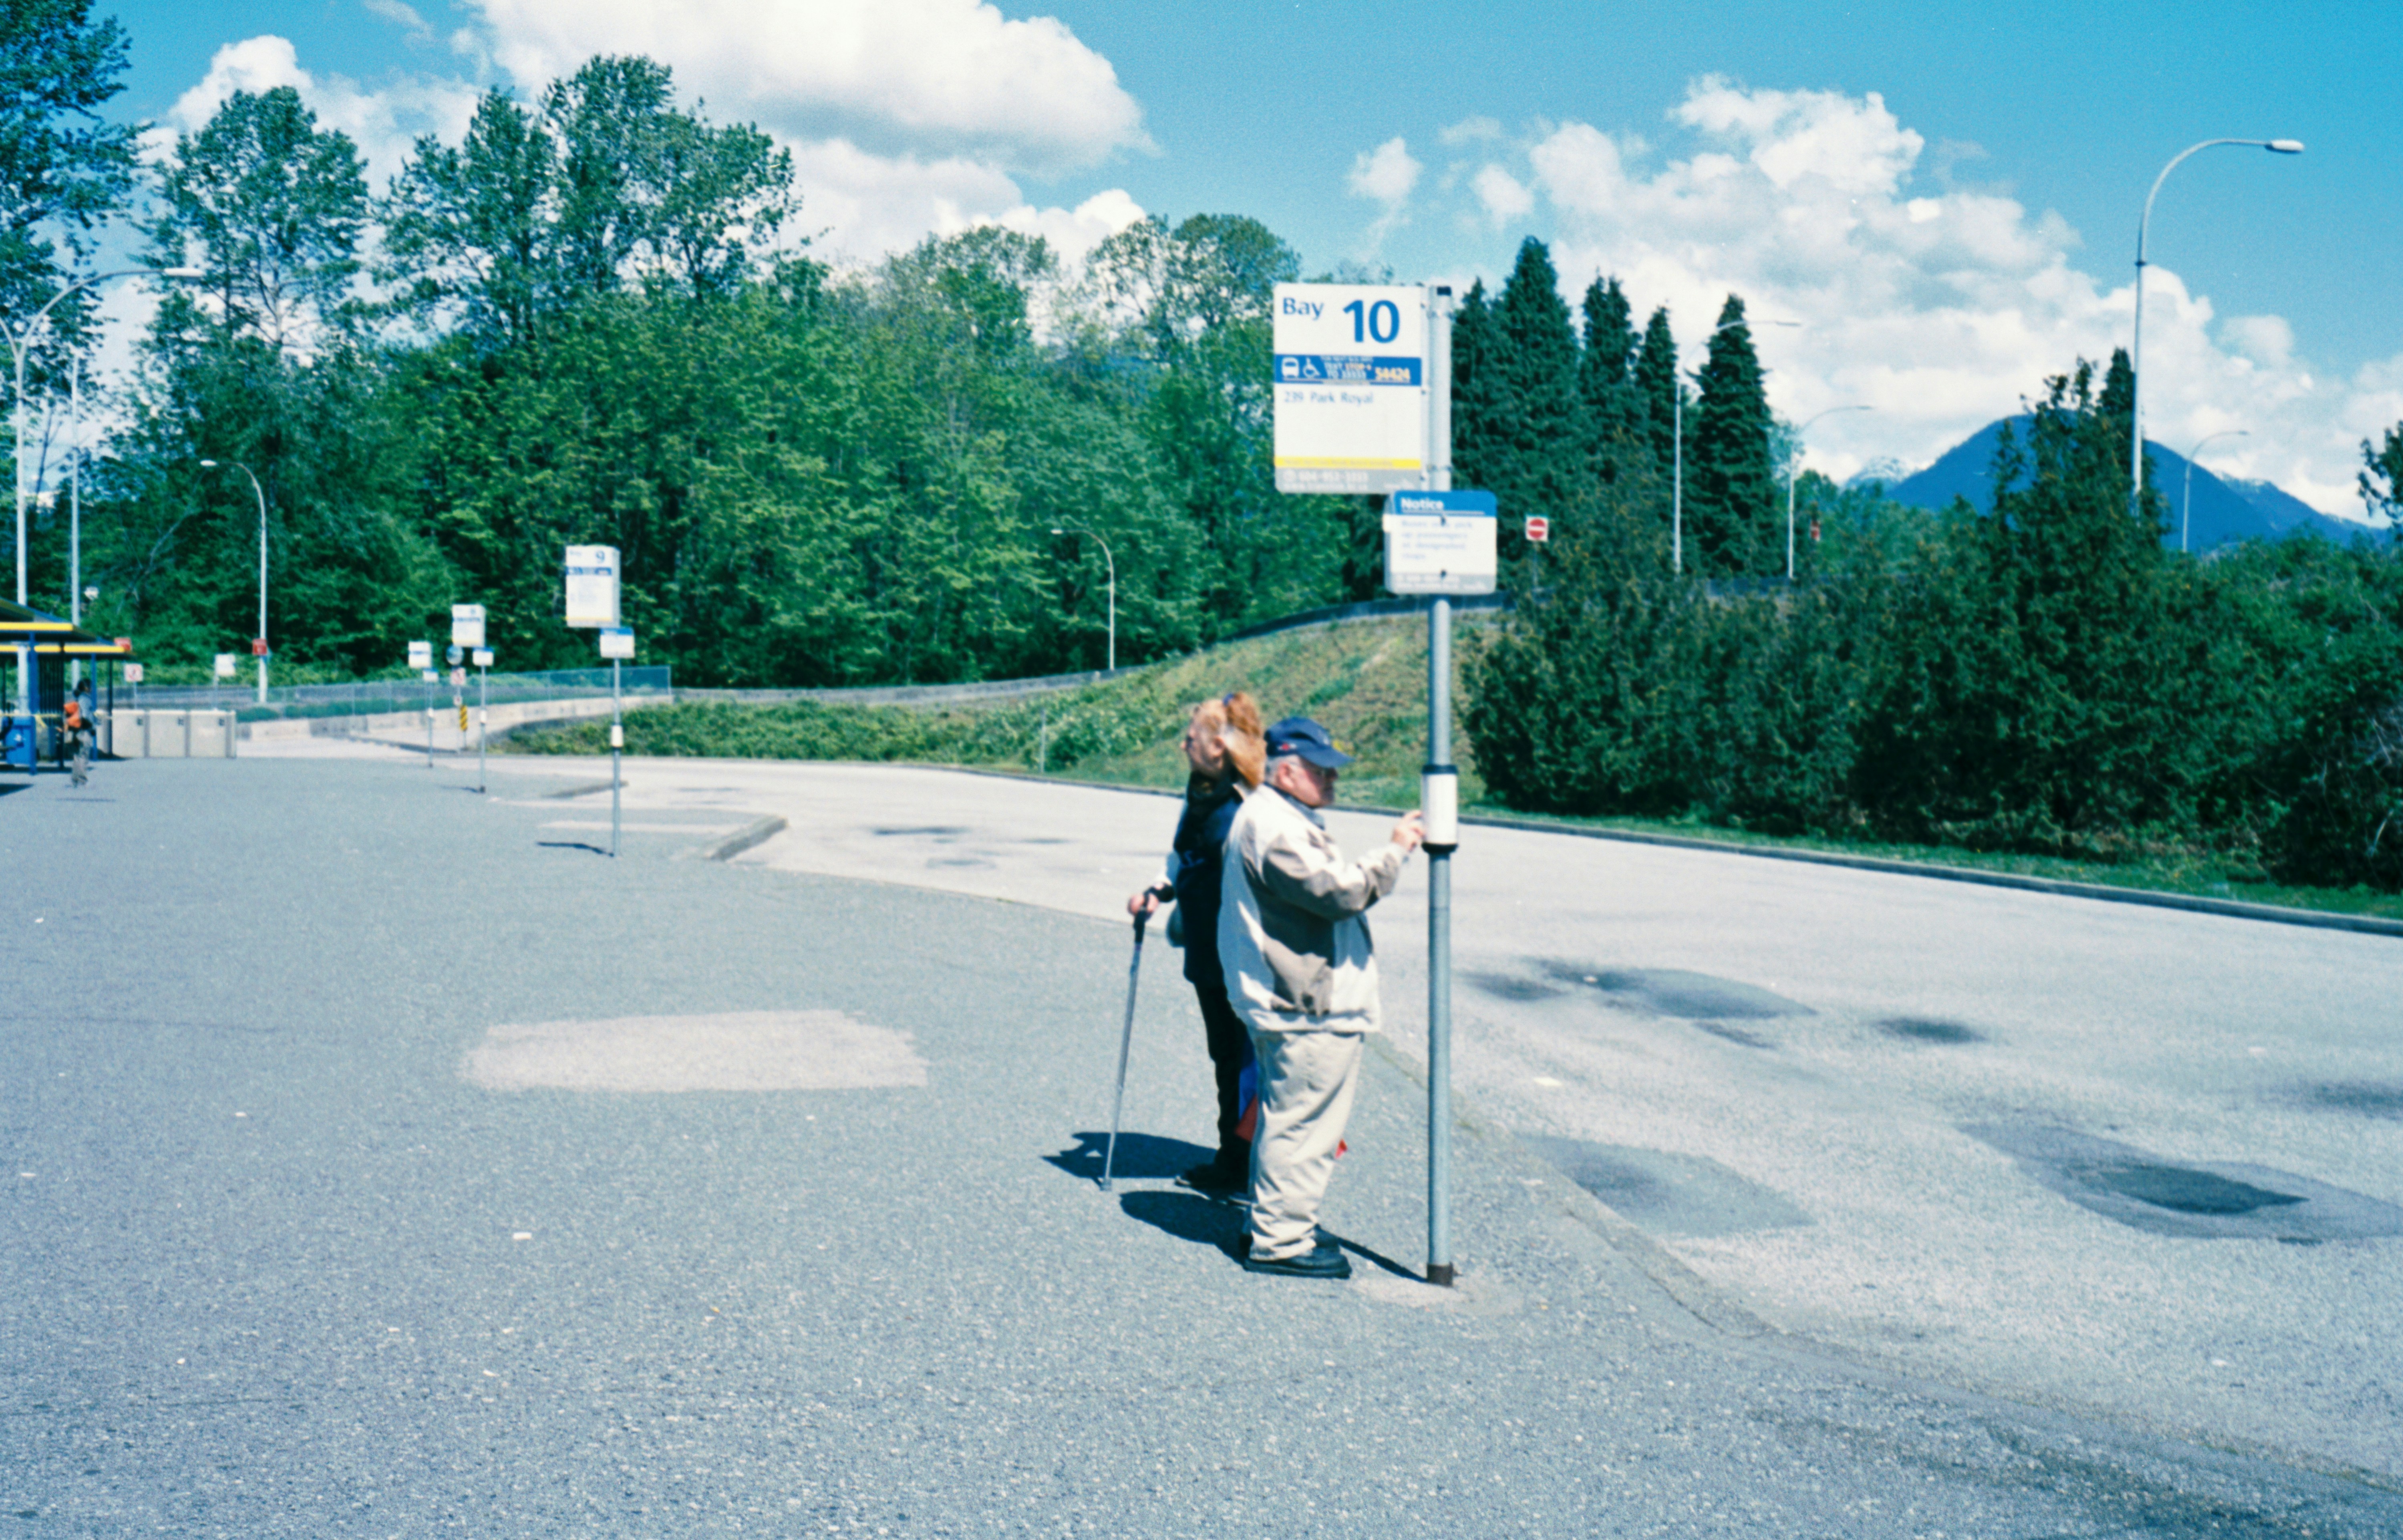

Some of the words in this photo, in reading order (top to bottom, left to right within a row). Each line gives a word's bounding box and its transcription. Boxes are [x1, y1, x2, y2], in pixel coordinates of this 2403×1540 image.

[1283, 298, 1323, 320] Bay
[1343, 300, 1400, 343] 10
[1310, 391, 1335, 403] Park
[1340, 392, 1373, 405] Royal
[1401, 497, 1443, 509] Notice
